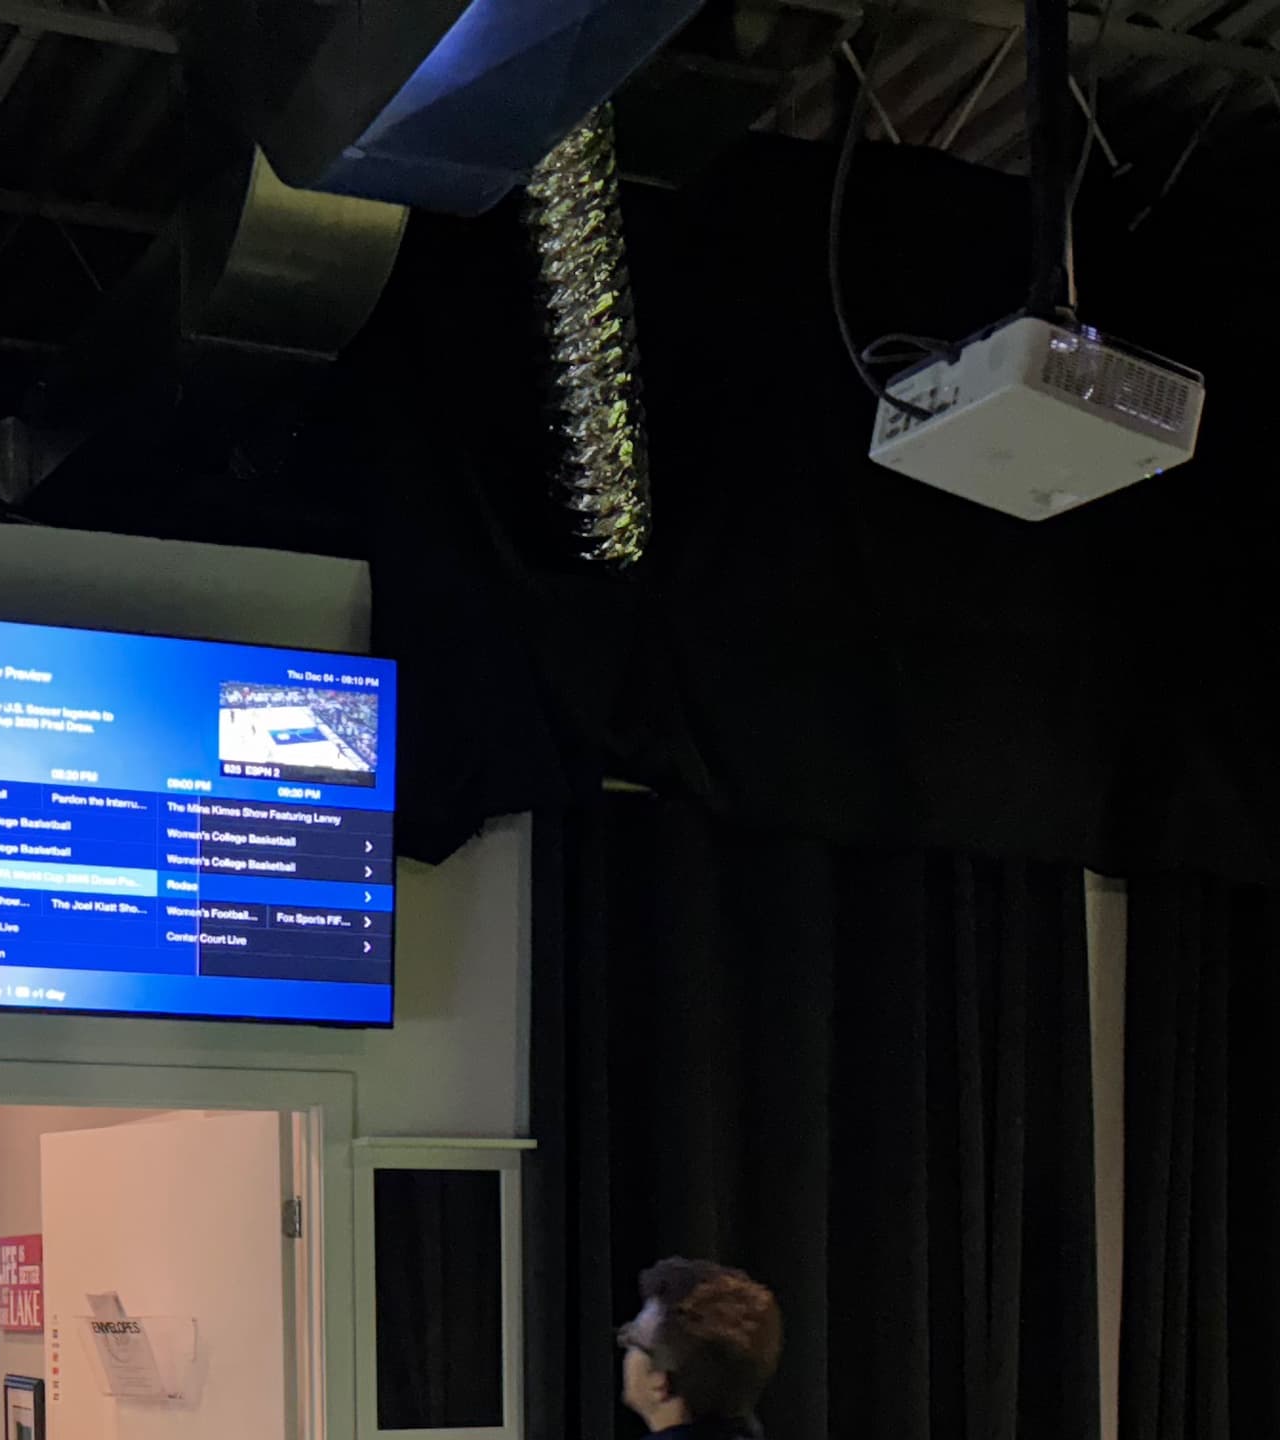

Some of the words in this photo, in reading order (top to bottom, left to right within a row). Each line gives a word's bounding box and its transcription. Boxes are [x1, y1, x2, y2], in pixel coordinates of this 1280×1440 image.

[5, 666, 53, 683] Preview
[287, 669, 304, 680] Thu
[305, 671, 322, 682] Dec
[365, 676, 380, 687] PM
[79, 770, 99, 783] PM
[244, 764, 272, 777] ESPN
[273, 767, 280, 778] 2
[195, 780, 212, 792] PM
[52, 792, 88, 805] Pardon
[88, 795, 104, 807] the
[304, 788, 321, 800] PM
[167, 801, 186, 813] The
[211, 804, 241, 817] Kimes
[242, 807, 269, 819] Show
[270, 809, 313, 825] Featuring
[20, 817, 72, 831] Basketball
[167, 828, 210, 841] Women's
[211, 831, 248, 845] College
[248, 833, 296, 847] Basketball
[20, 843, 72, 857] Basketball
[167, 853, 210, 867] Women's
[211, 857, 248, 870] College
[248, 859, 296, 872] Basketball
[51, 899, 70, 911] The
[71, 901, 93, 912] Joel
[167, 905, 209, 919] Women's
[276, 912, 295, 923] Fox
[295, 913, 326, 926] Sports
[166, 931, 198, 943] Center
[199, 933, 226, 944] Court
[227, 934, 247, 946] Live
[9, 1289, 41, 1326] LAKE
